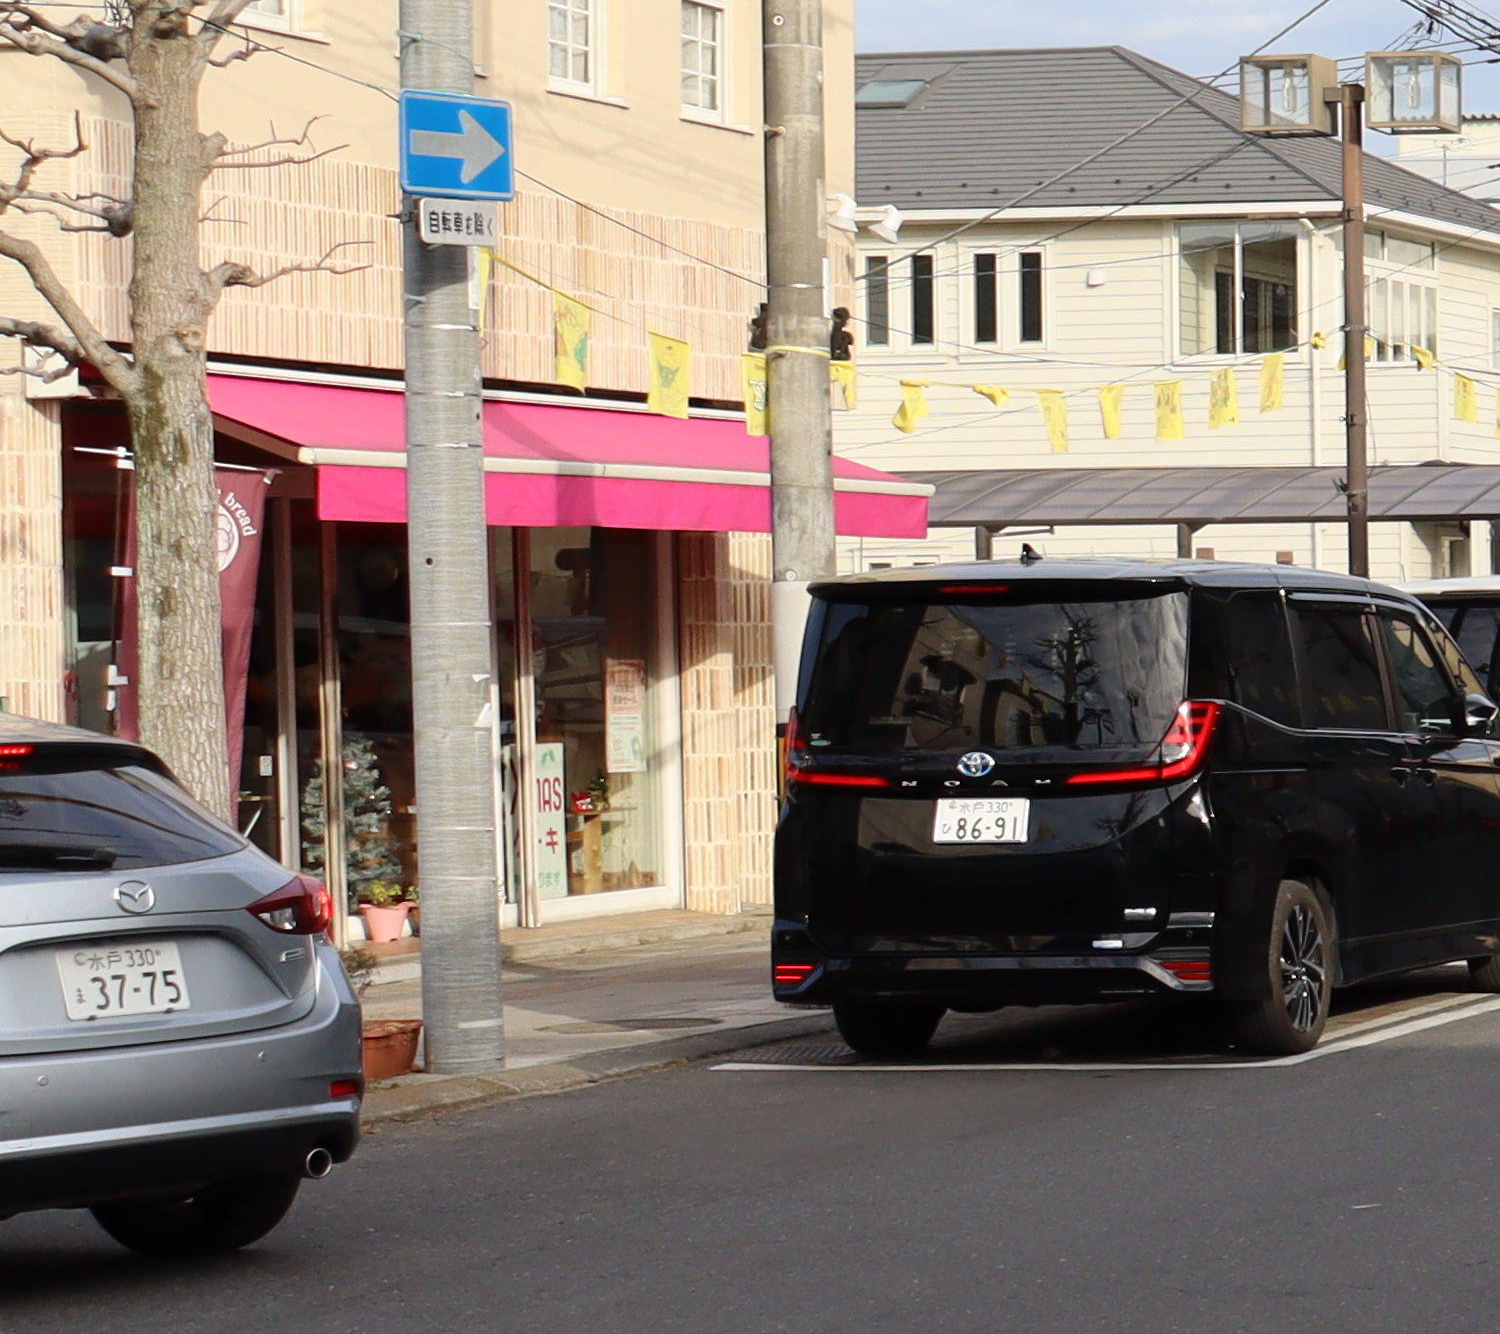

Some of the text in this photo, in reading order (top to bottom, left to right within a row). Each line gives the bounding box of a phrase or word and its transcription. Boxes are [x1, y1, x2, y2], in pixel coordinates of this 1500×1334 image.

[429, 210, 494, 237] 自転車を除く
[224, 491, 258, 537] bread
[958, 801, 1009, 814] 水戸 330
[942, 817, 1019, 840] ひ 86-91
[87, 948, 156, 972] 水戸 330
[75, 969, 183, 1011] ま 37-75
